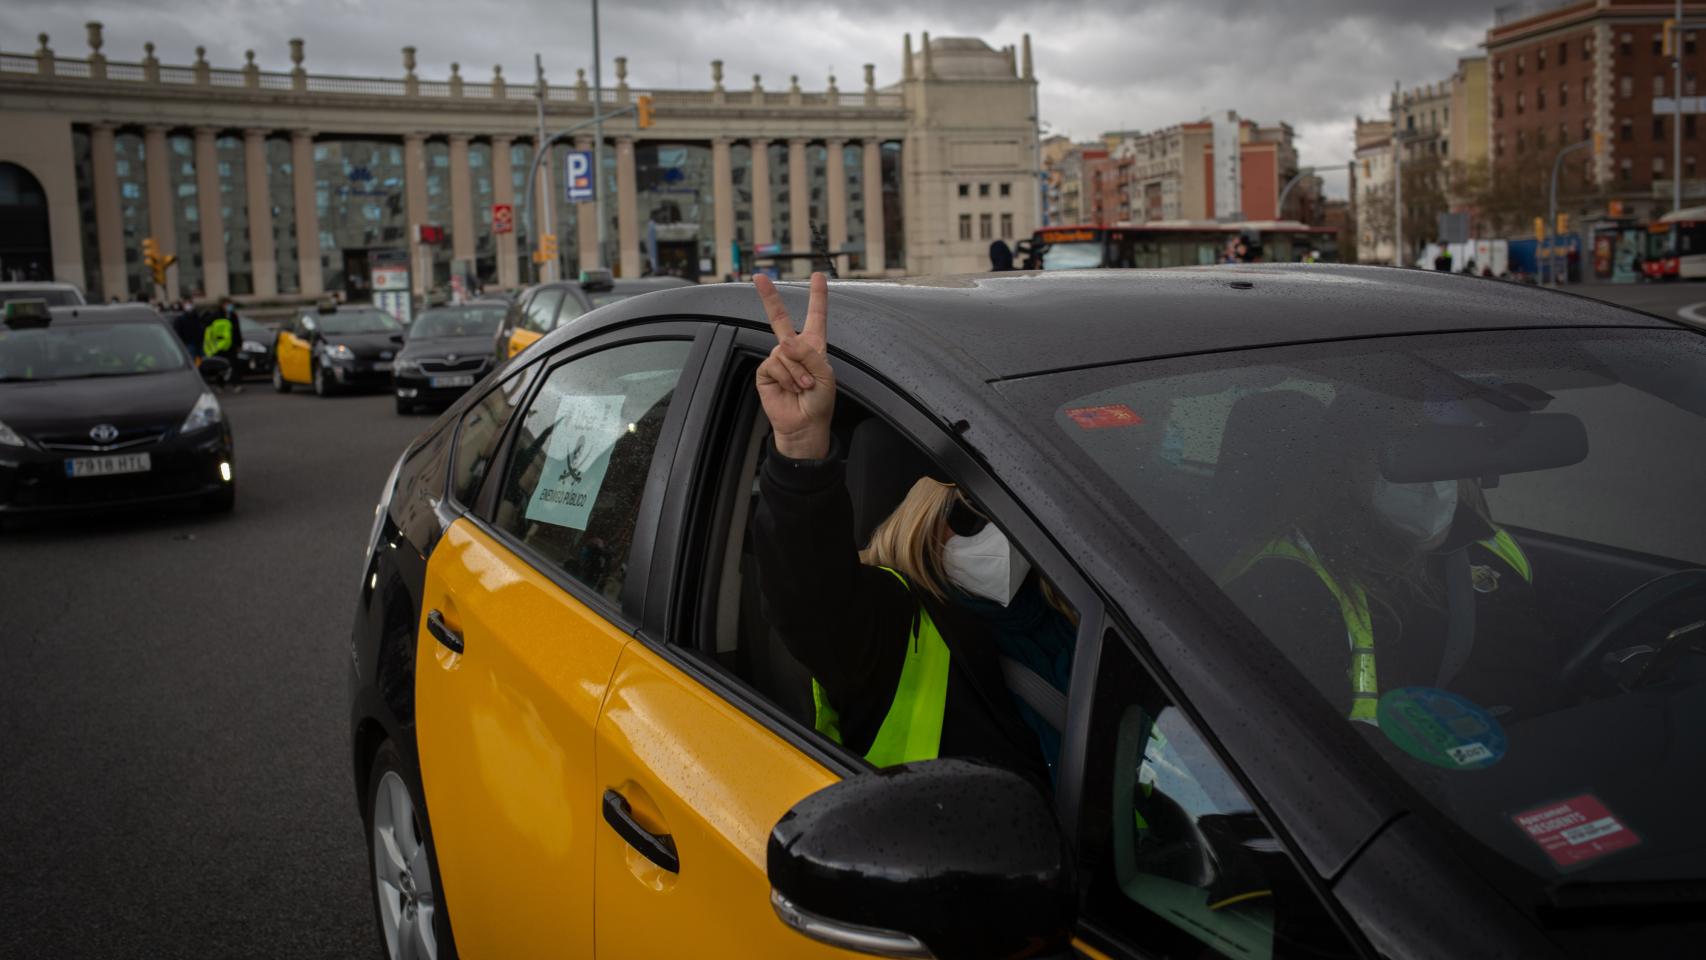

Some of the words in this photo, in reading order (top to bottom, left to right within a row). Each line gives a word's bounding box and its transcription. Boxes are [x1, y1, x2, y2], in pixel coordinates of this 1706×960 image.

[567, 153, 588, 187] P
[76, 459, 113, 475] 7918
[539, 488, 565, 504] ENEMIGO
[1526, 811, 1587, 835] RESIDENTS
